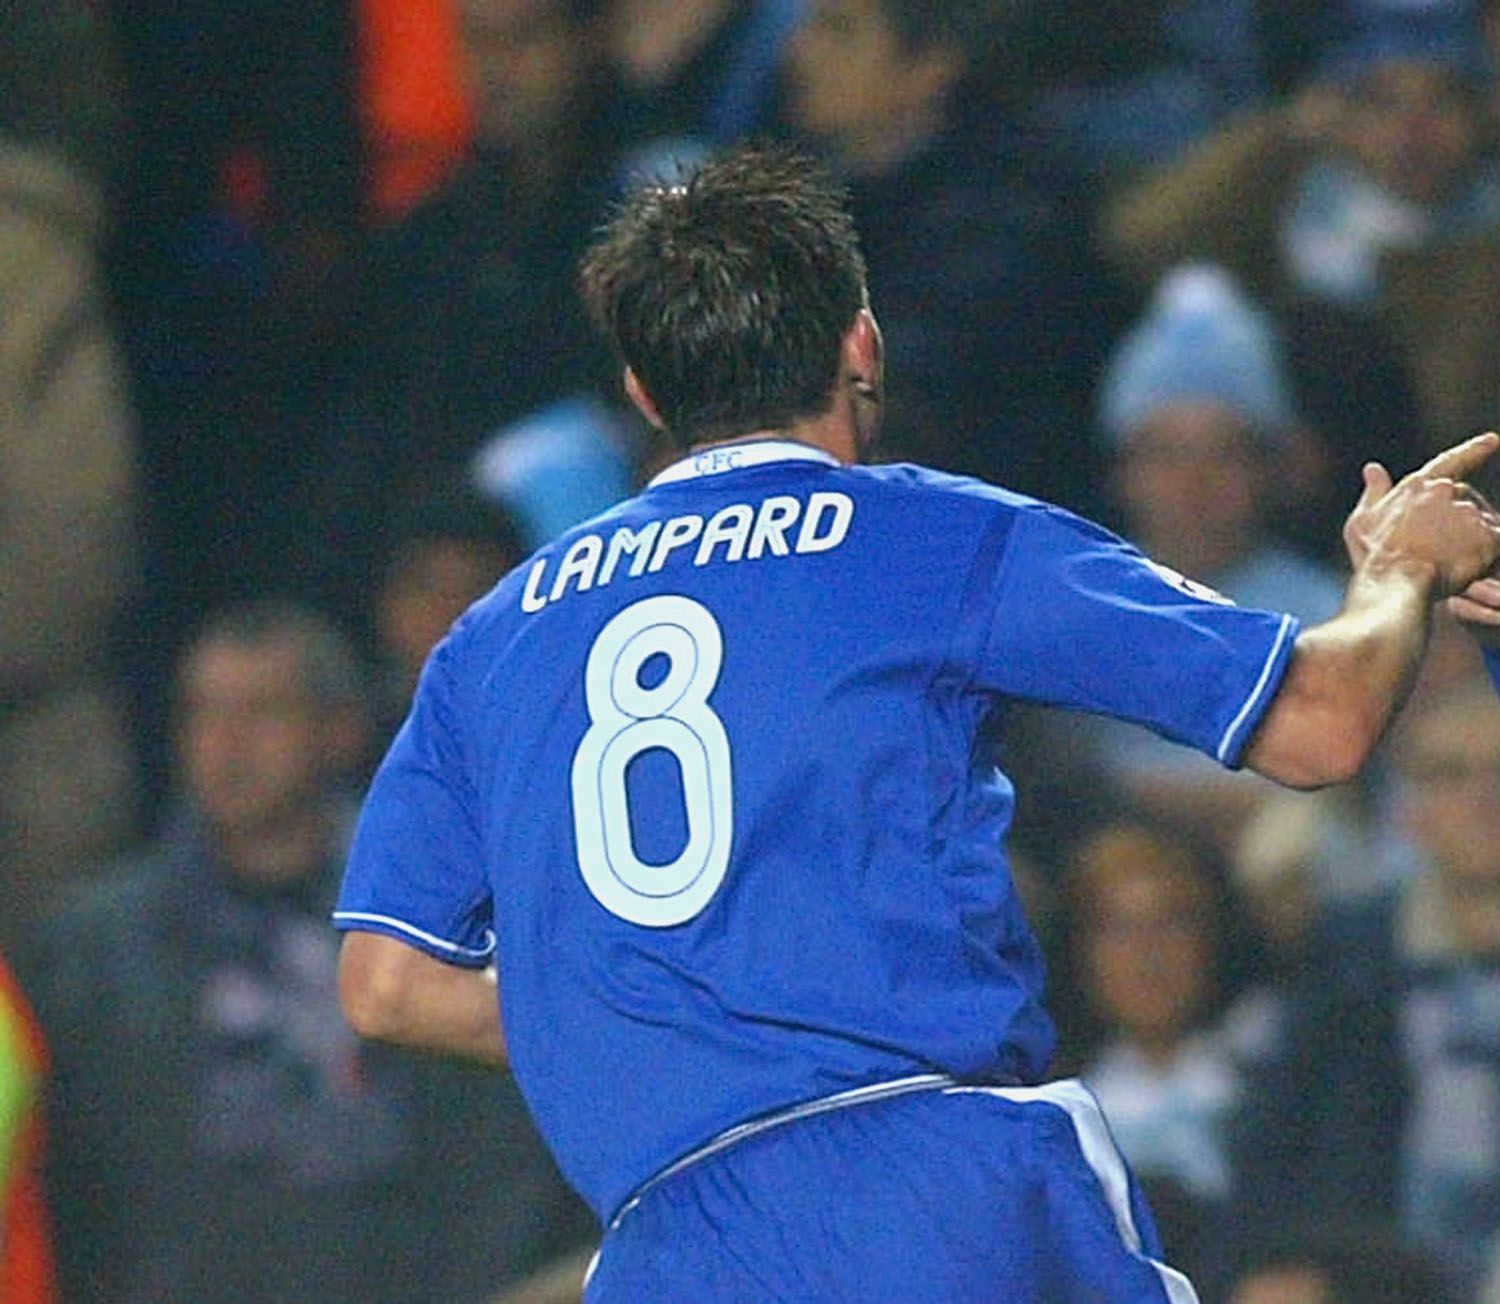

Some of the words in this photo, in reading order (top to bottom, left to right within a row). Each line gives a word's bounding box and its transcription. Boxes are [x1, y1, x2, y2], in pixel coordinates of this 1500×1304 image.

[694, 450, 743, 477] CFC
[520, 491, 854, 614] LAMPARD
[571, 593, 734, 928] 8
